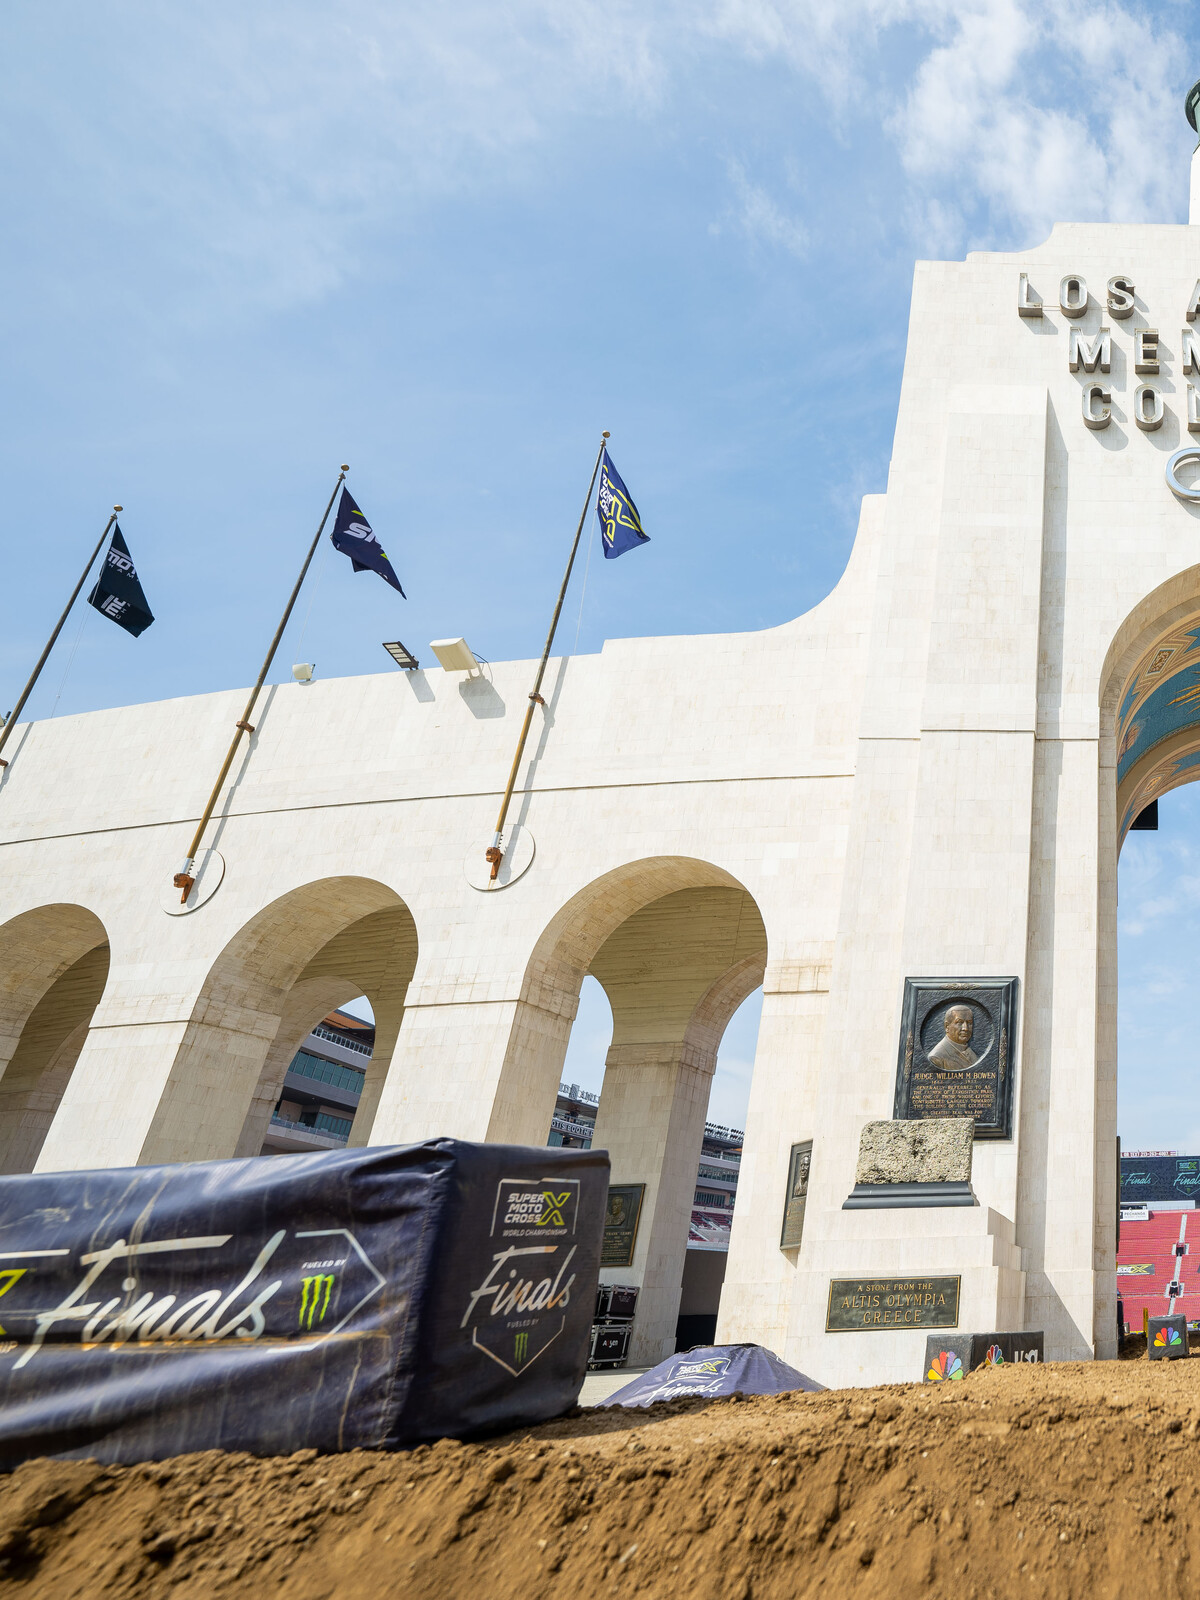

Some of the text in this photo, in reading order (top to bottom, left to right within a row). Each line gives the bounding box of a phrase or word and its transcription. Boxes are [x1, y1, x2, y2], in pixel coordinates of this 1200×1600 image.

[1018, 273, 1136, 320] LOS
[1125, 1172, 1152, 1186] Finals
[507, 1193, 545, 1203] SUPER
[508, 1203, 543, 1213] MOTO
[504, 1213, 542, 1224] CROSS
[502, 1228, 567, 1237] WORLD CHAMPIONSHIP
[302, 1259, 347, 1269] FUELED BY
[460, 1244, 578, 1329] Finals
[866, 1284, 891, 1292] STONE
[893, 1283, 915, 1291] FROM
[11, 1229, 286, 1370] Finals
[841, 1293, 946, 1309] ALTIS OLYMPIA
[863, 1309, 922, 1324] GREECE
[506, 1319, 531, 1328] FUELED
